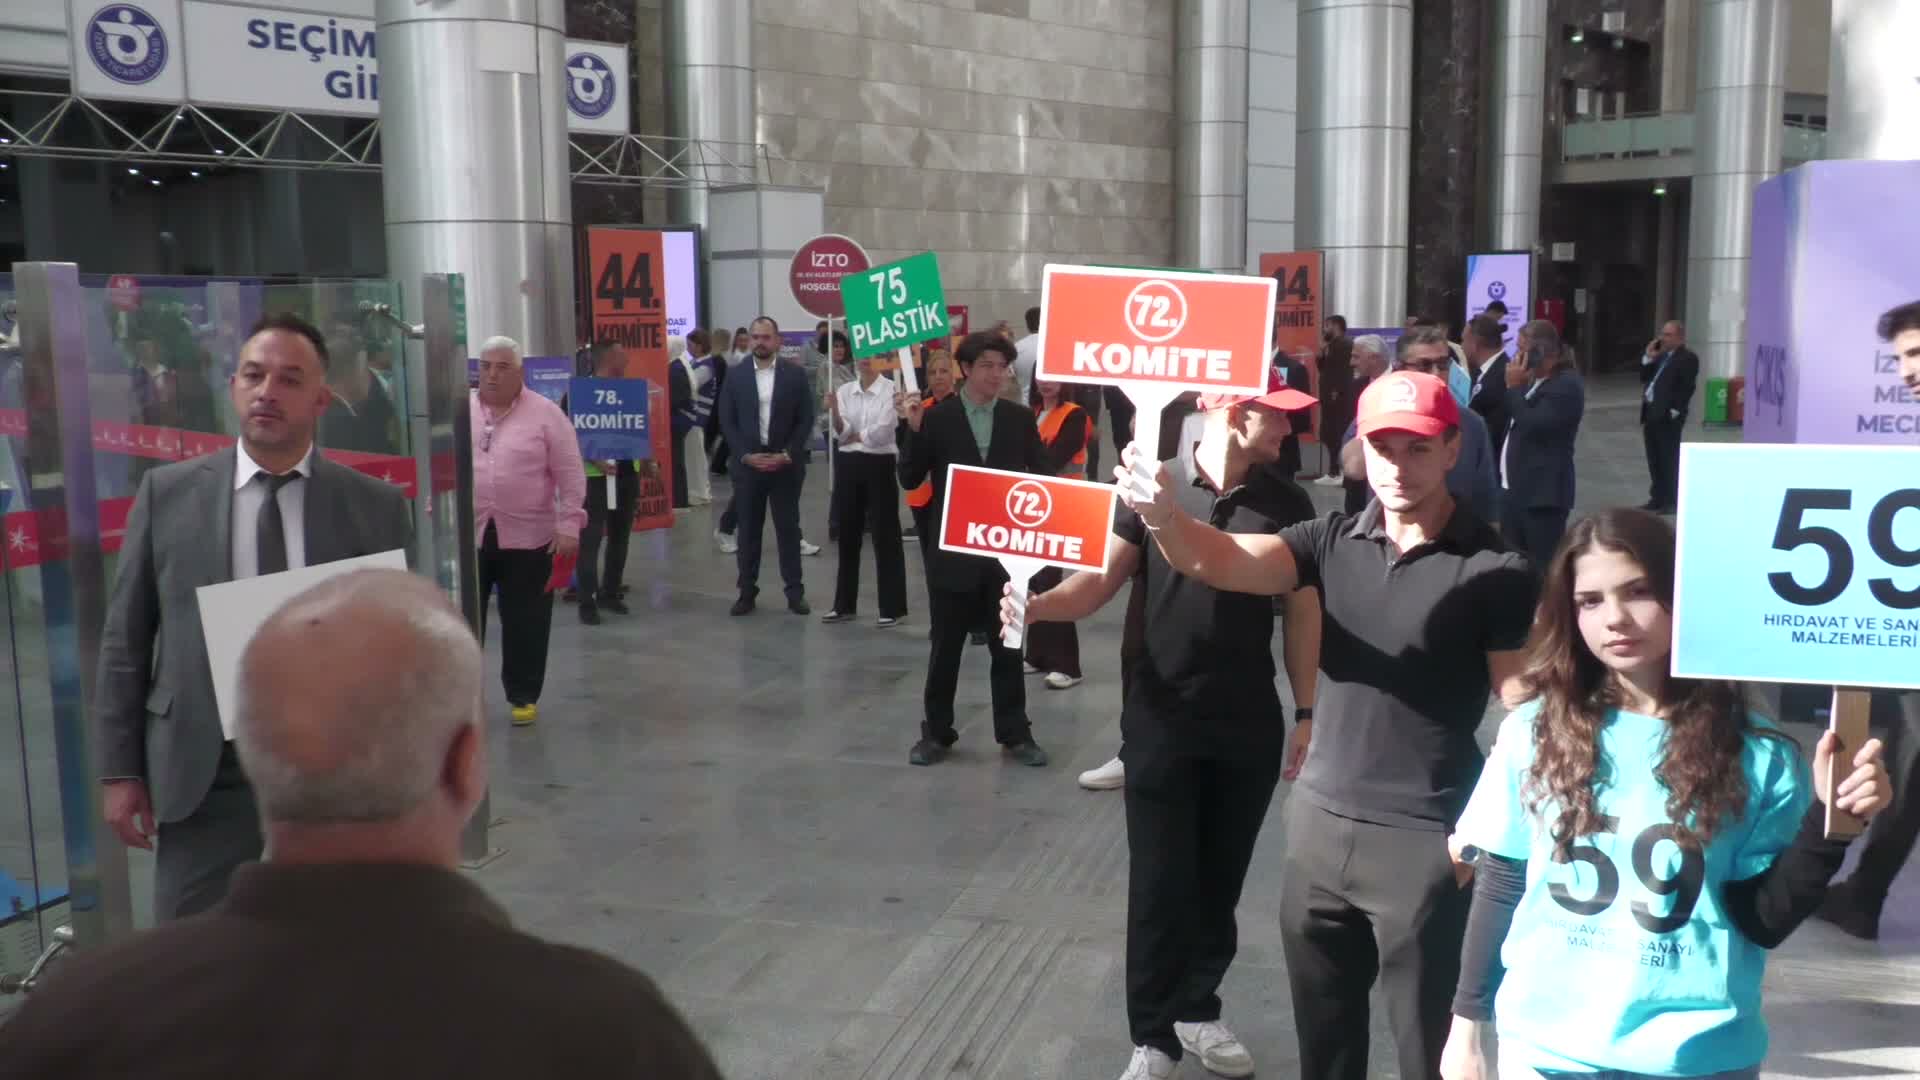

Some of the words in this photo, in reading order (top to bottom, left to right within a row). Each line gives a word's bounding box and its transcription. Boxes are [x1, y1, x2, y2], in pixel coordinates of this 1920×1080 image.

[247, 18, 377, 63] SEÇİM
[811, 250, 849, 268] İZTO
[596, 252, 662, 310] 44.
[869, 266, 908, 311] 75
[851, 300, 944, 350] PLASTİK
[1133, 294, 1179, 328] 72.
[594, 389, 623, 406] 78.
[573, 410, 645, 429] KOMİTE
[1012, 490, 1046, 517] 72.
[1767, 487, 1920, 610] 59
[1763, 613, 1849, 629] HIRDAVAT
[1855, 616, 1877, 630] VE
[1791, 630, 1917, 648] MALZEMELERİ
[1547, 815, 1705, 934] 59
